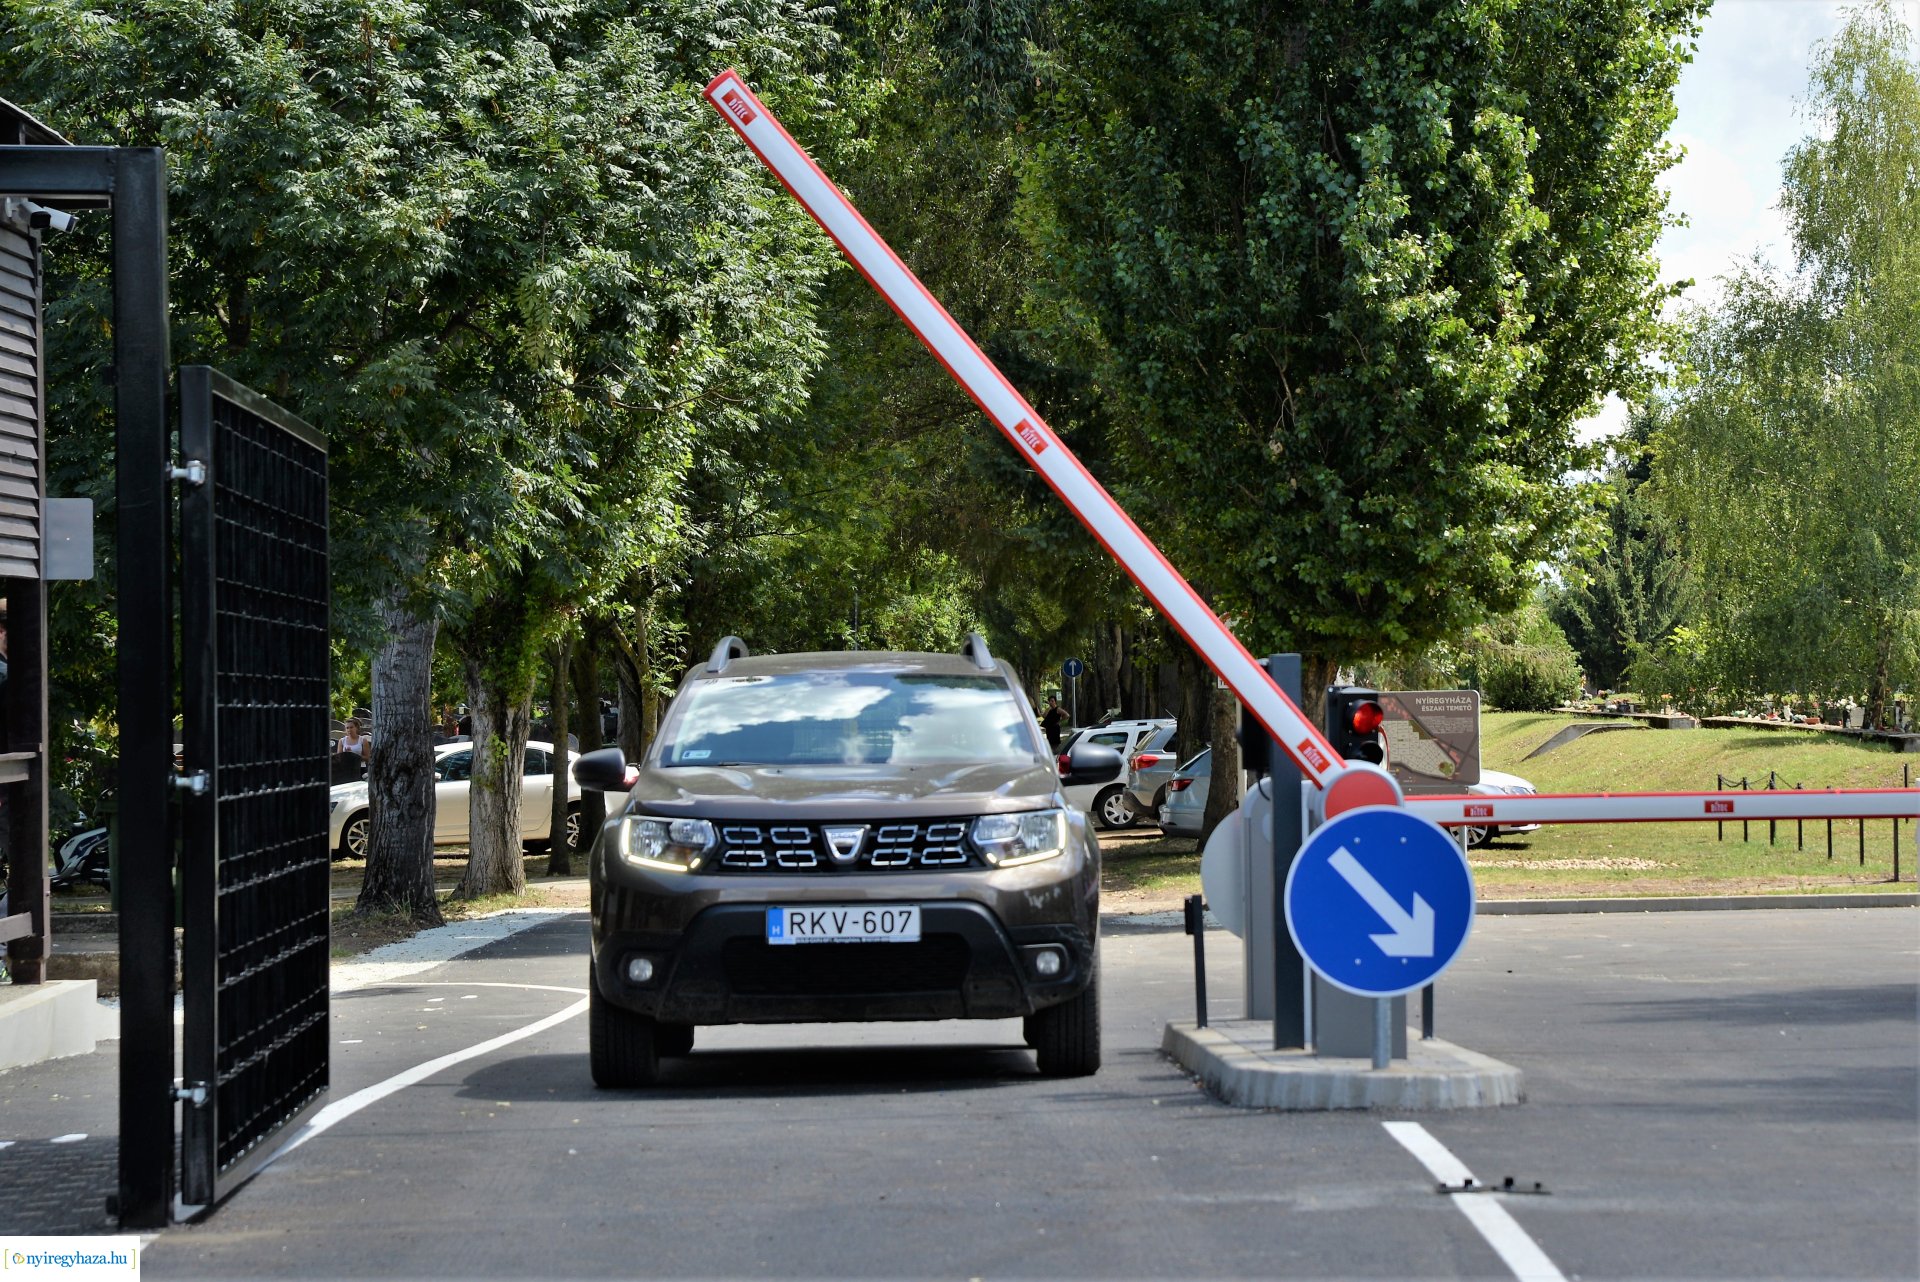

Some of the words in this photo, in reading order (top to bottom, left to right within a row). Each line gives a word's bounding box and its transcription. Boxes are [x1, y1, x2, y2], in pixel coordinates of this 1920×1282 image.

[1415, 696, 1472, 705] NYÍREGYHÁZA
[1421, 704, 1445, 712] ÉSZAKI
[790, 911, 912, 935] RKV-607
[772, 926, 780, 935] H
